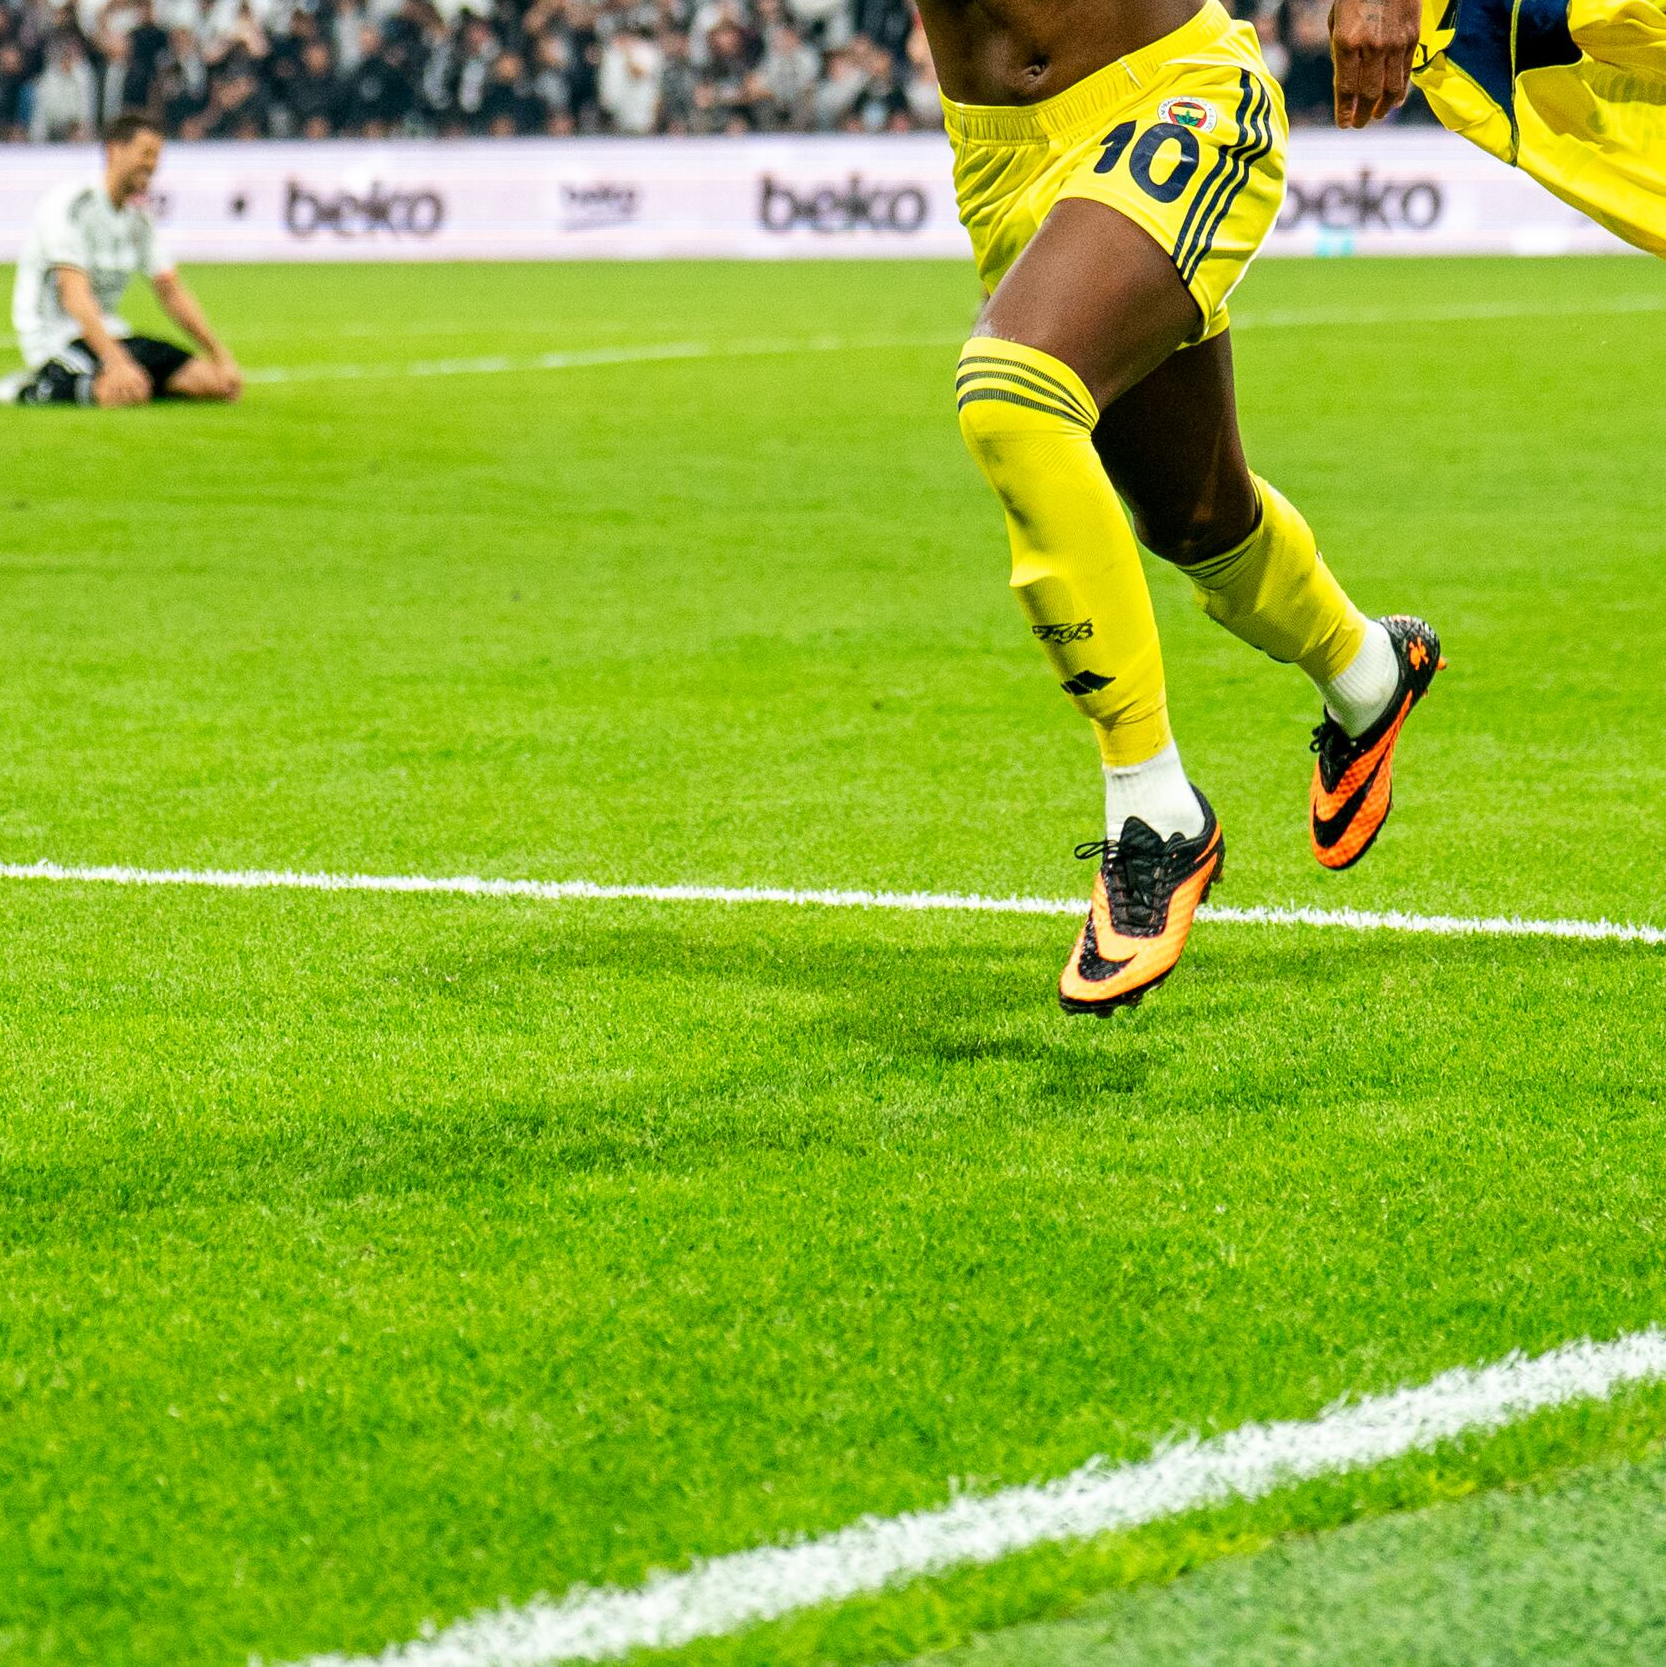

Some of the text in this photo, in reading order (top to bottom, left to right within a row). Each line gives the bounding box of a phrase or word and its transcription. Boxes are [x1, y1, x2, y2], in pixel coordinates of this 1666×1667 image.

[1094, 120, 1199, 203] 10
[283, 173, 444, 239] beko
[758, 171, 929, 234] beko
